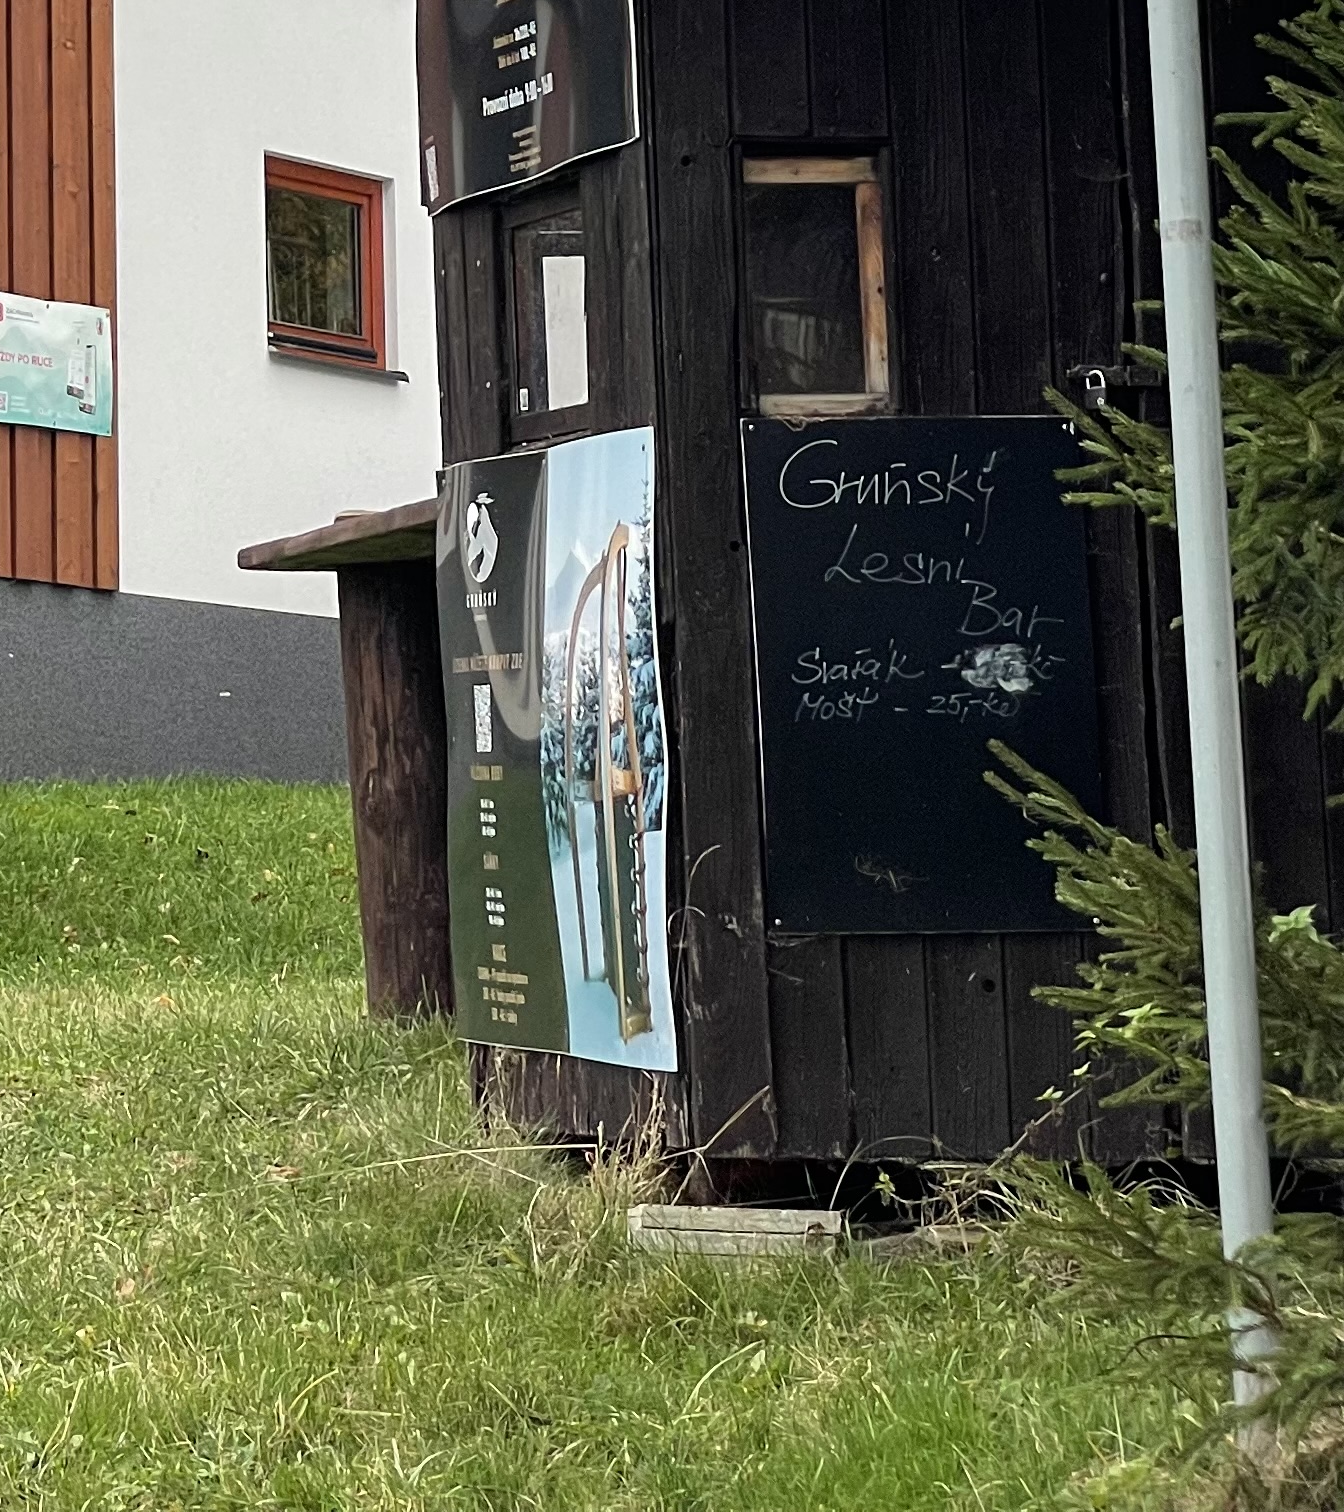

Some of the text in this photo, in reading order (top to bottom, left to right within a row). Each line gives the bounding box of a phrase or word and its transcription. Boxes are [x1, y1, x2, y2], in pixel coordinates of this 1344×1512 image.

[17, 352, 30, 364] PO
[31, 355, 54, 368] RUCE
[960, 579, 1064, 637] Bar
